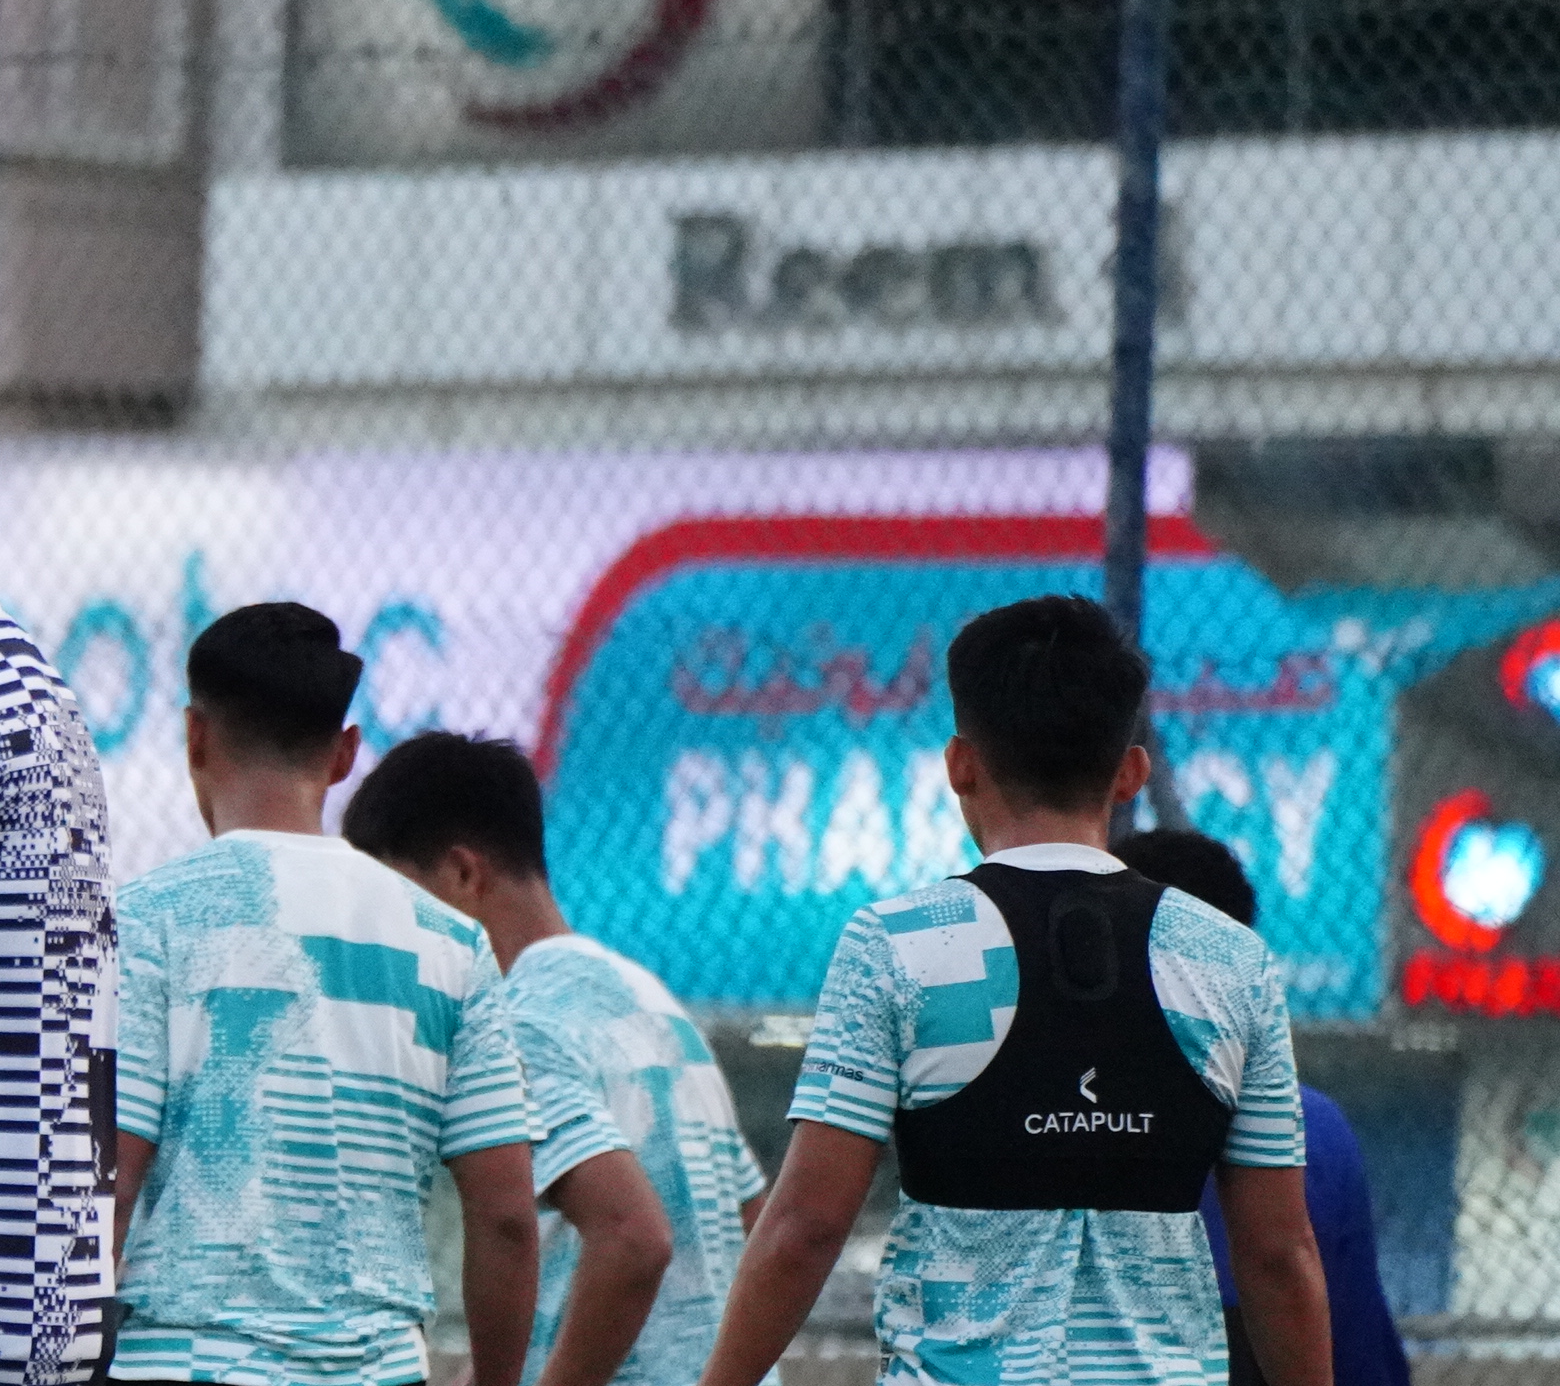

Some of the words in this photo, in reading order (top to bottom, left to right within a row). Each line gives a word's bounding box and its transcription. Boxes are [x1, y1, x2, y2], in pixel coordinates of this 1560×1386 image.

[668, 211, 1065, 330] Reem
[662, 749, 1338, 898] PHARCY
[1024, 1110, 1154, 1135] CATAPULT
